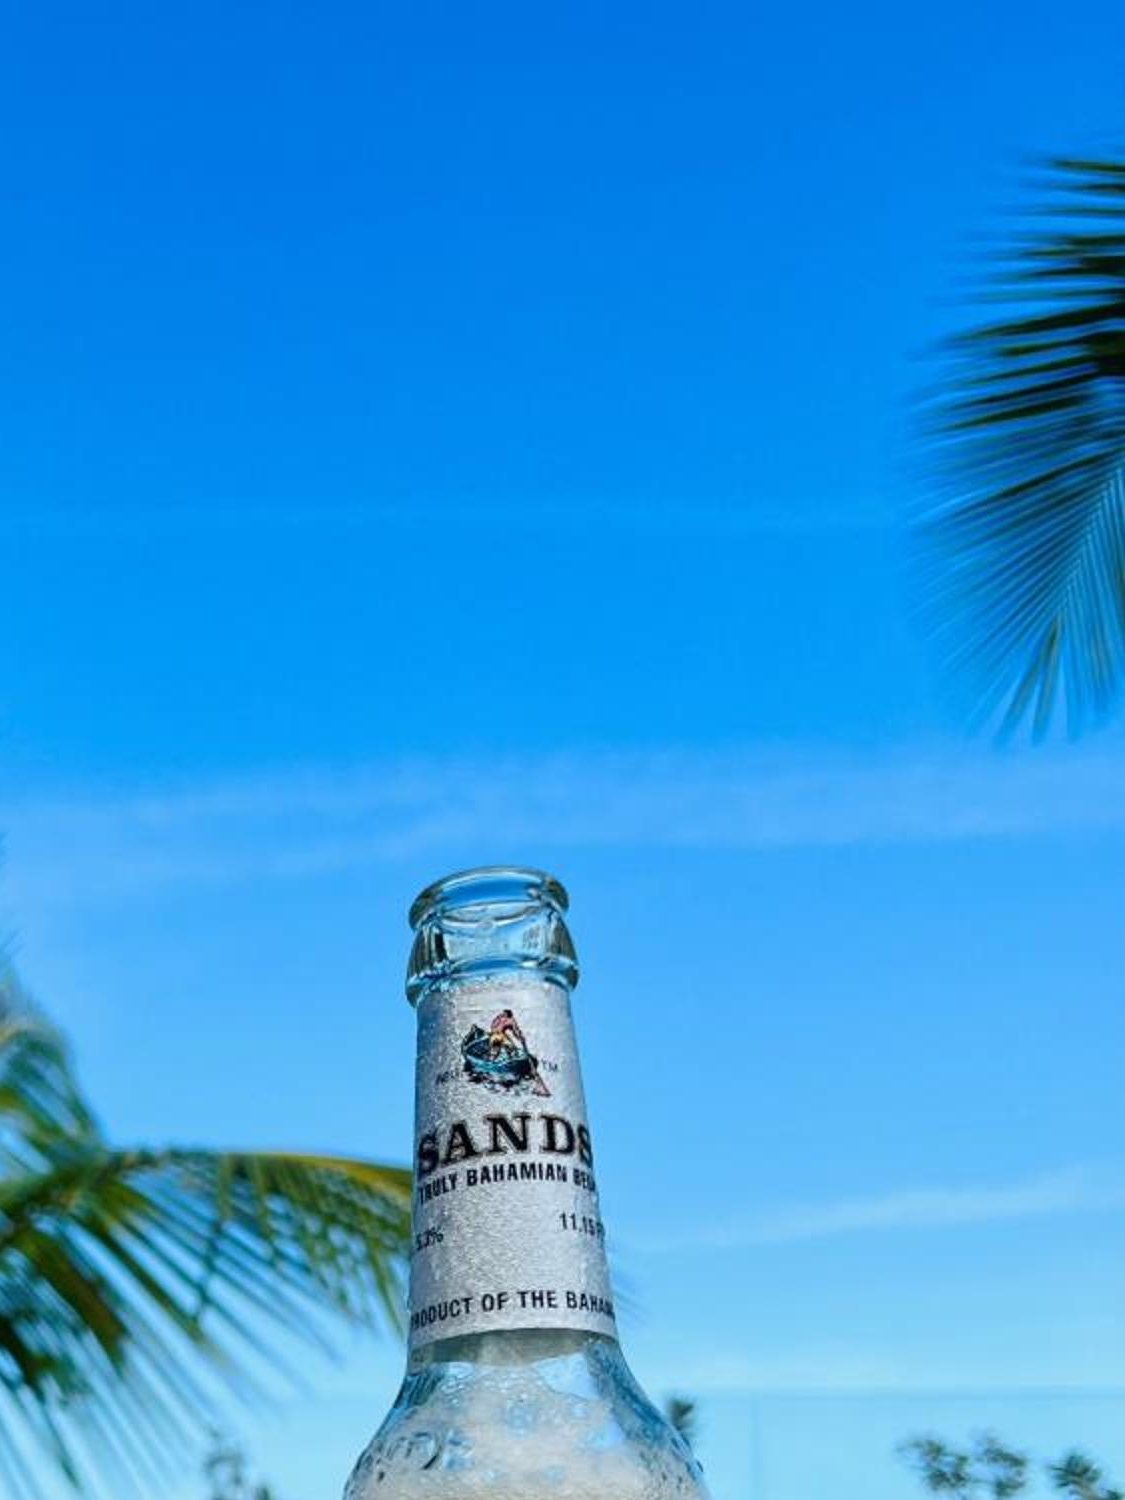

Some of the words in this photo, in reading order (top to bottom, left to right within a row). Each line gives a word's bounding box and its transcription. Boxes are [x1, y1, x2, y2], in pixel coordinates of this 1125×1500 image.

[418, 1112, 594, 1175] SANDS
[466, 1162, 568, 1187] BAHAMIAN
[481, 1292, 509, 1312] OF
[517, 1290, 559, 1310] THE
